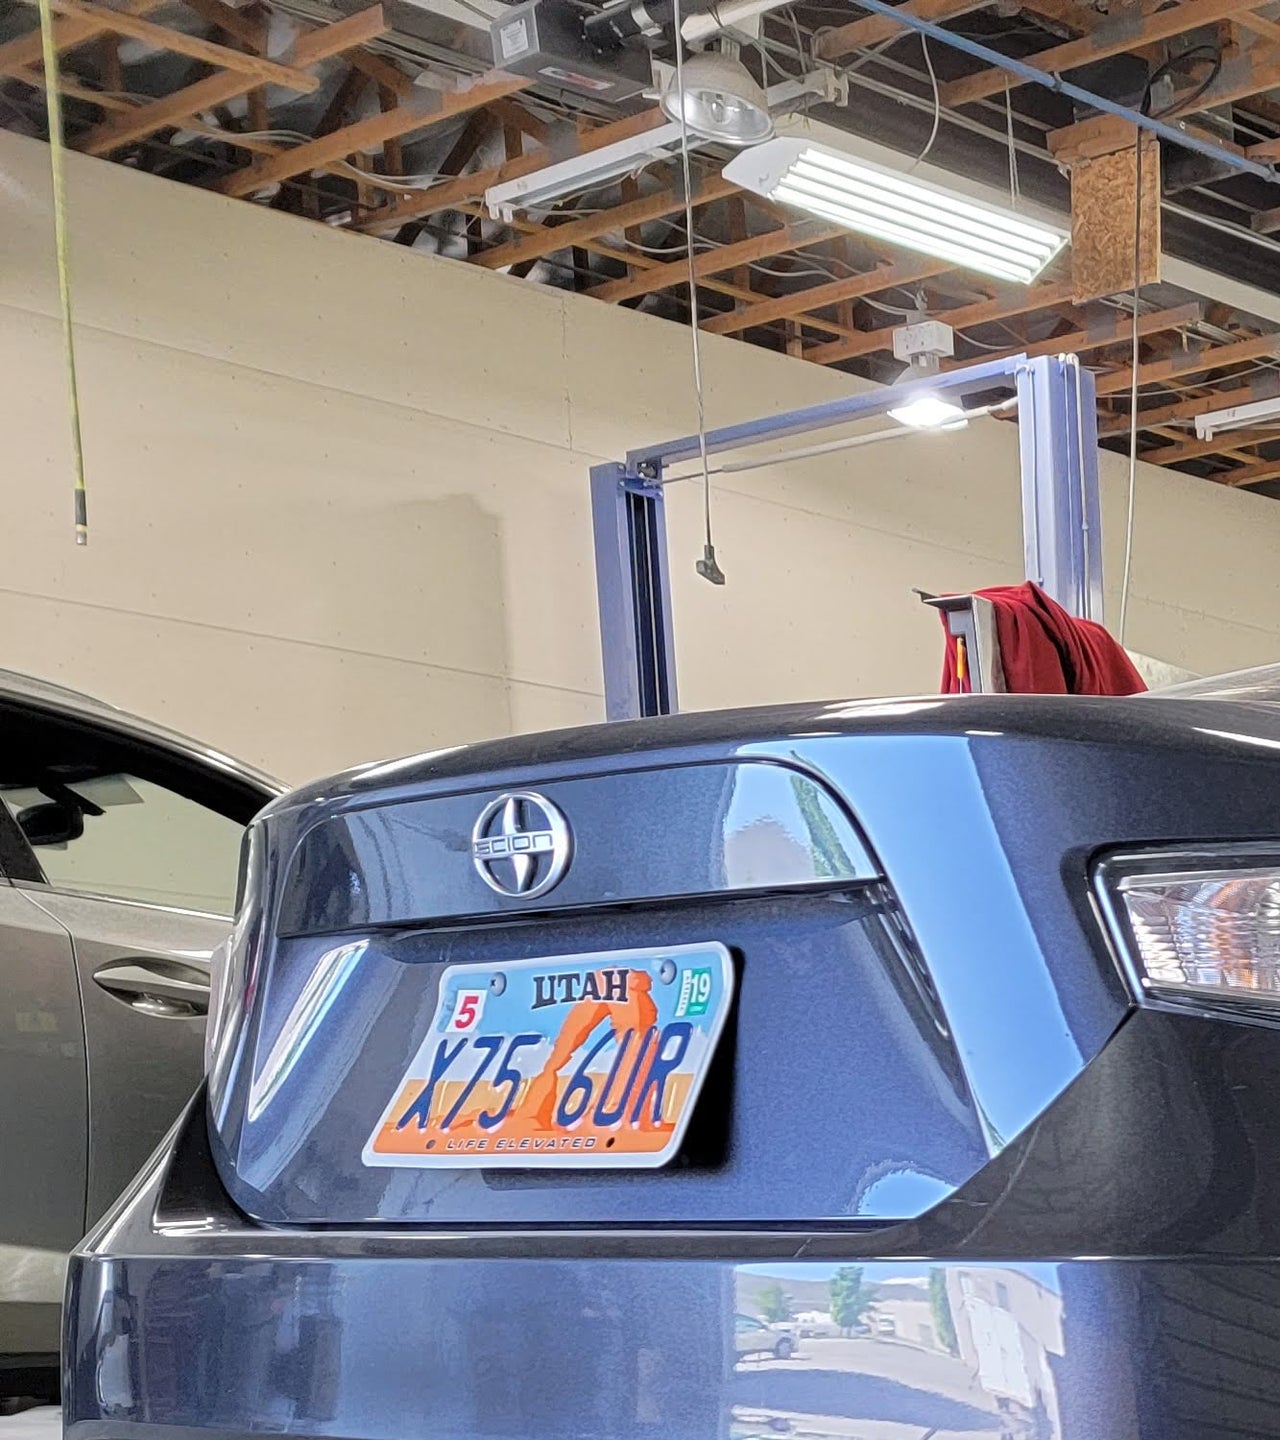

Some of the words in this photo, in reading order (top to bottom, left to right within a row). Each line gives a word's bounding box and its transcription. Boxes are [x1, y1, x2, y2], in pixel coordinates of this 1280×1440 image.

[532, 968, 630, 1010] UTAH
[689, 972, 711, 1003] 19
[455, 996, 479, 1029] 5
[395, 1033, 543, 1130] X75
[556, 1022, 693, 1129] 6UR
[446, 1138, 489, 1150] LIFE
[495, 1137, 597, 1149] ELEVATED
